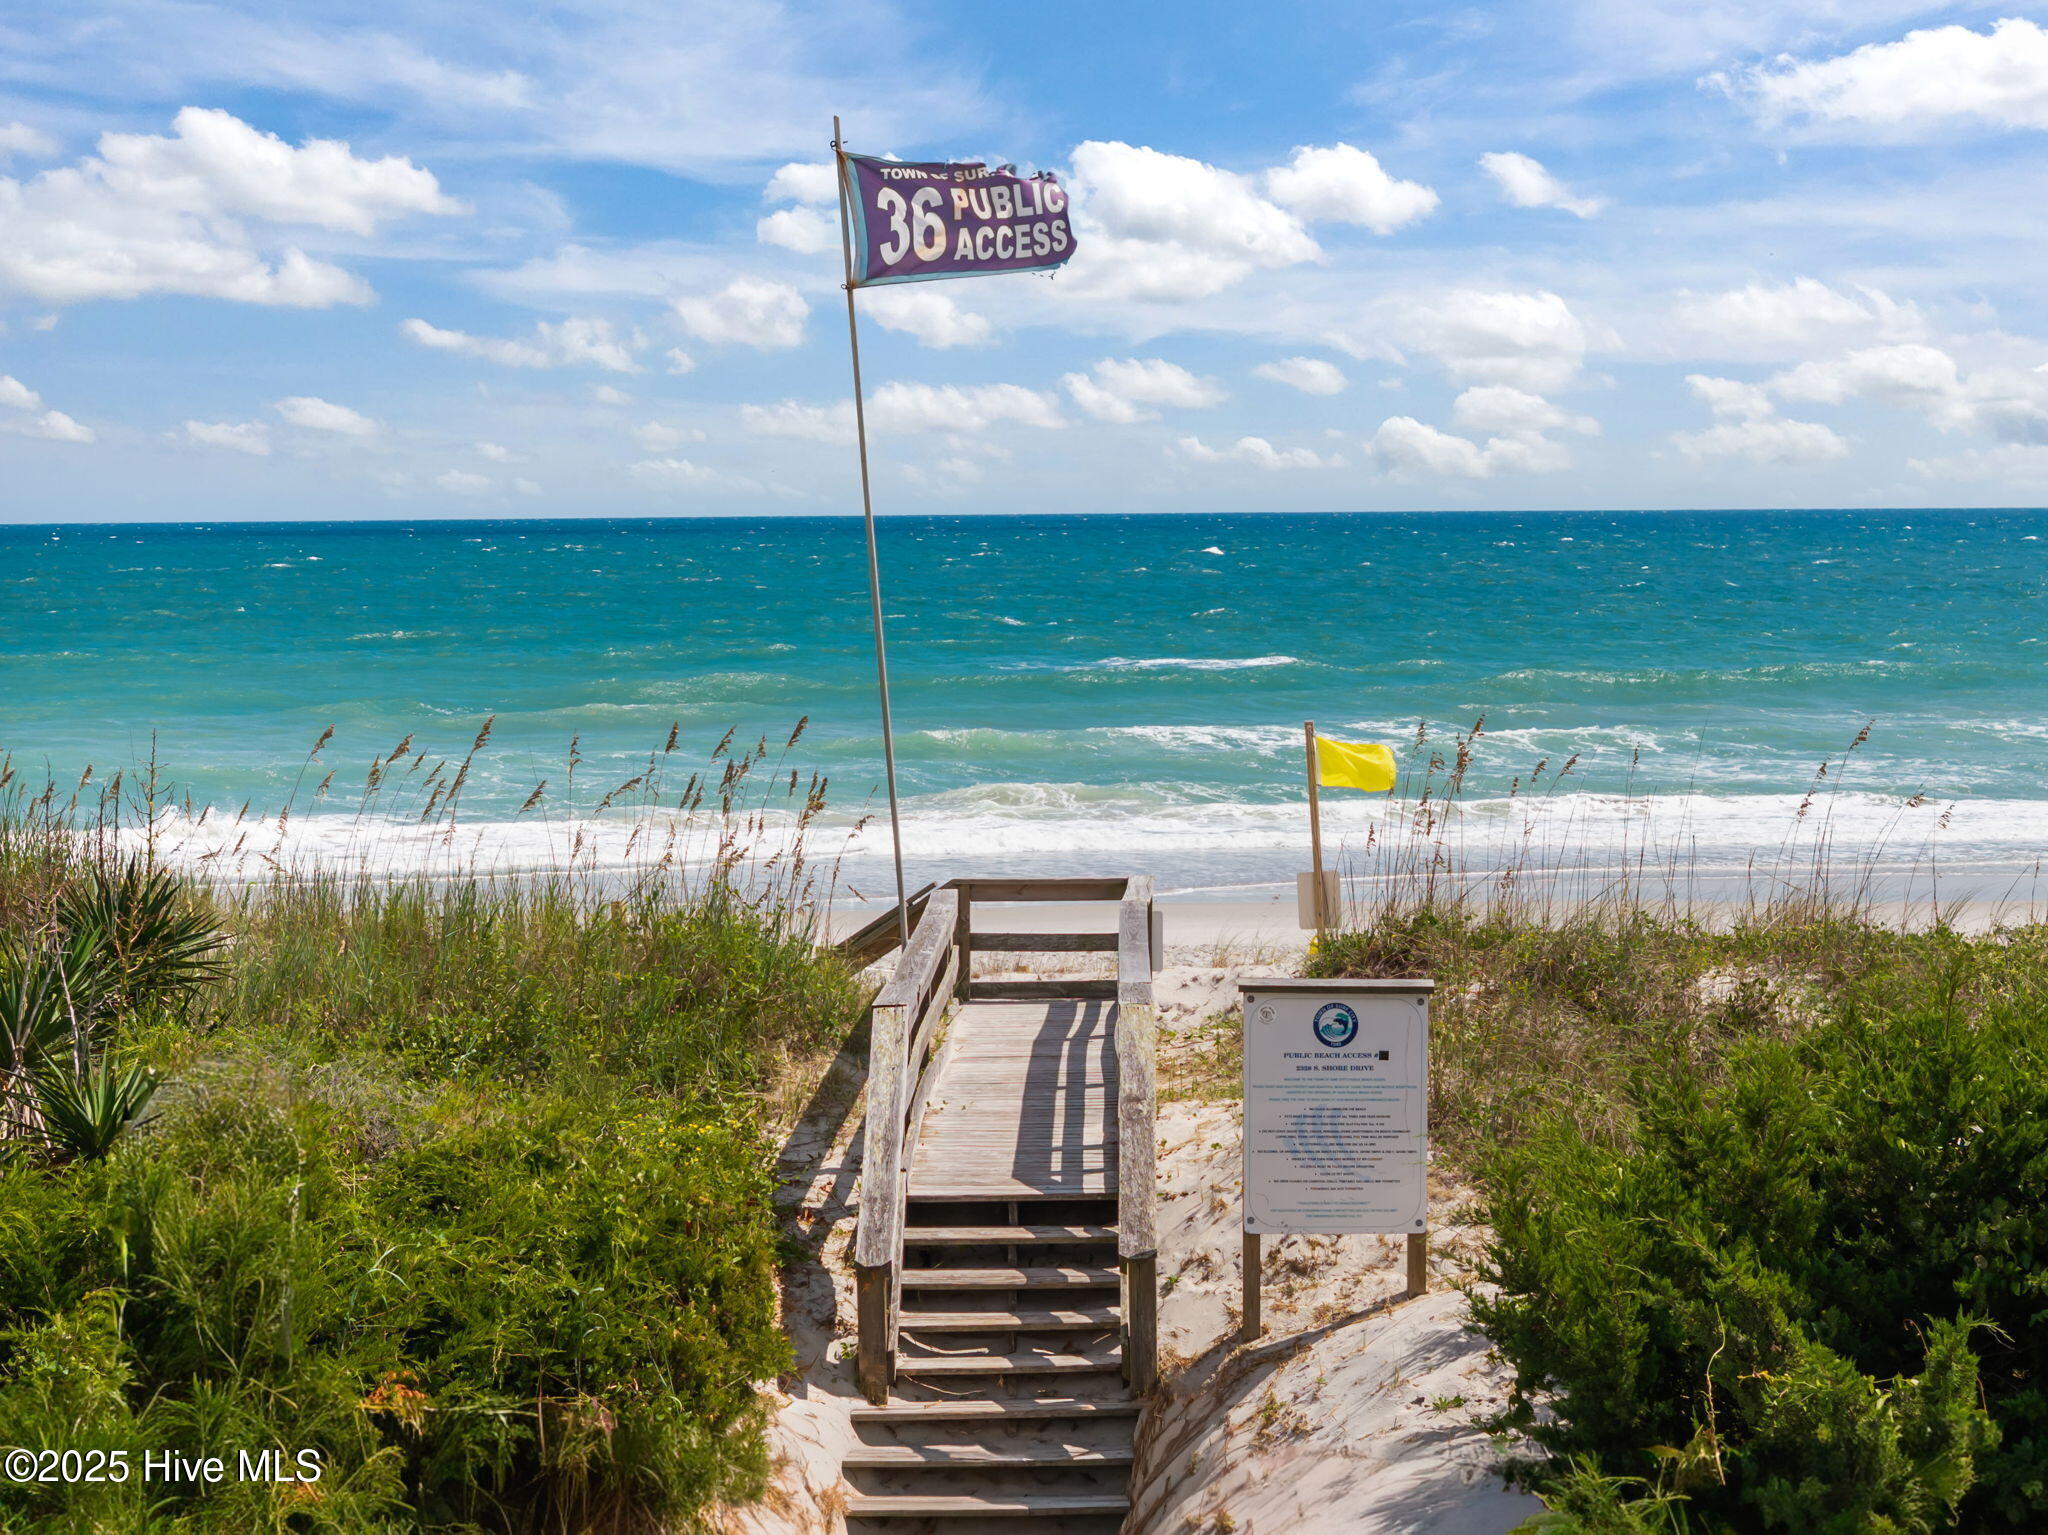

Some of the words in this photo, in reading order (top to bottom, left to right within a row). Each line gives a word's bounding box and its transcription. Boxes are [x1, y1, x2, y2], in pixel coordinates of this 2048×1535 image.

[880, 168, 928, 180] TOWN
[950, 182, 1065, 221] PUBLIC
[877, 186, 947, 266] 36
[953, 219, 1069, 261] ACCESS
